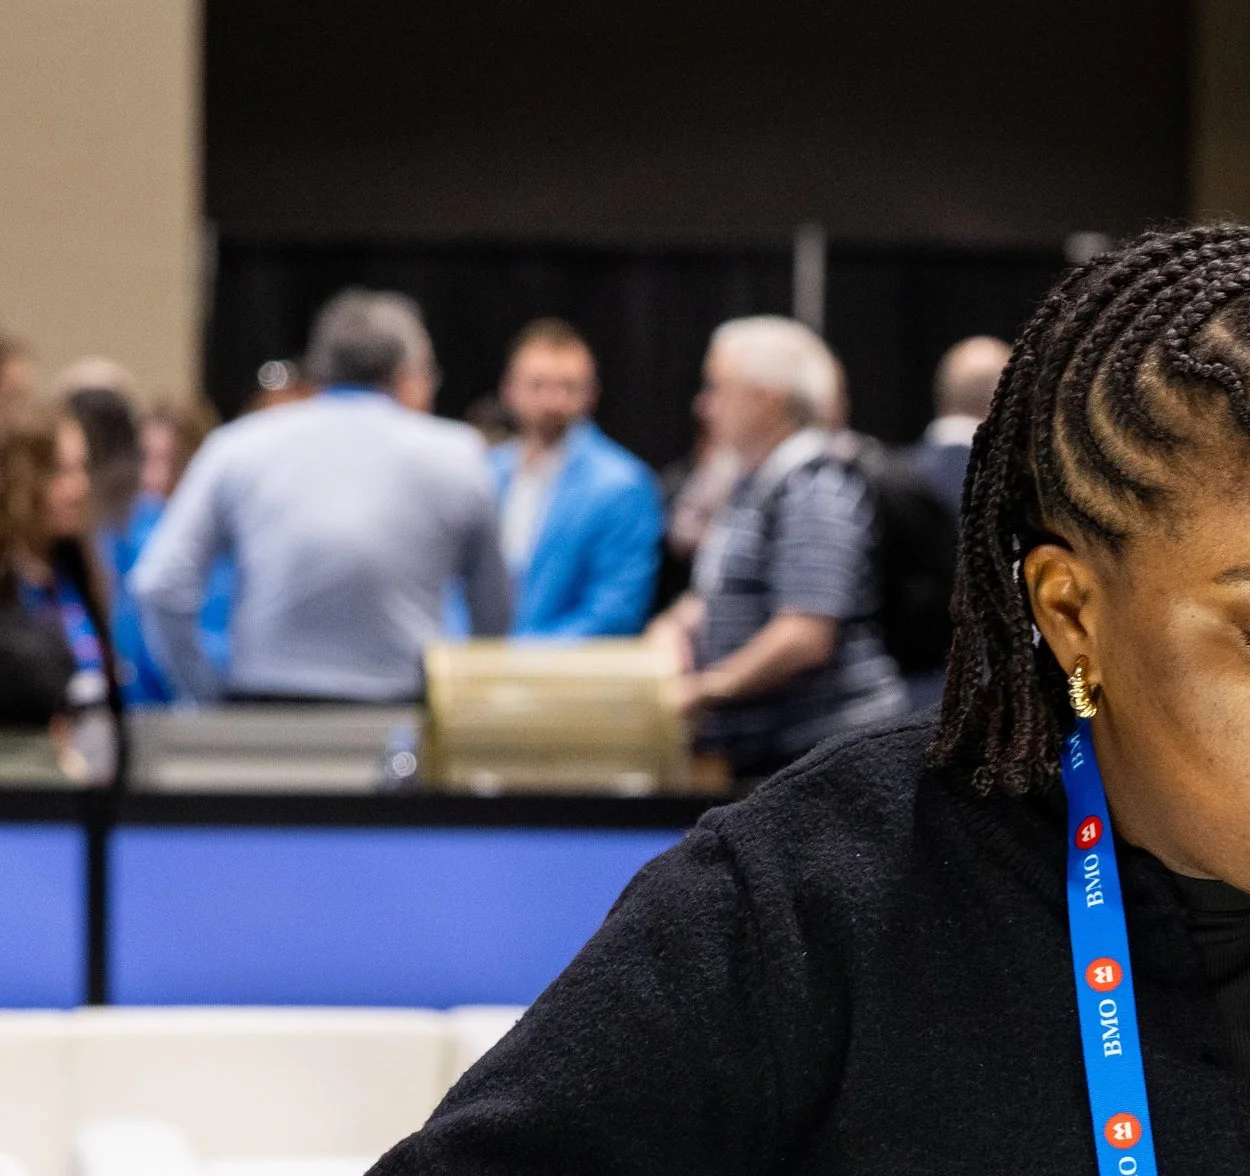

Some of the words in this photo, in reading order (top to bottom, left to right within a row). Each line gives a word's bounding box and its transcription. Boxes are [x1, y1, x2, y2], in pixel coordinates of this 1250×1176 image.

[1070, 733, 1084, 770] BM
[1084, 853, 1104, 908] BMO
[1098, 998, 1123, 1057] BMO
